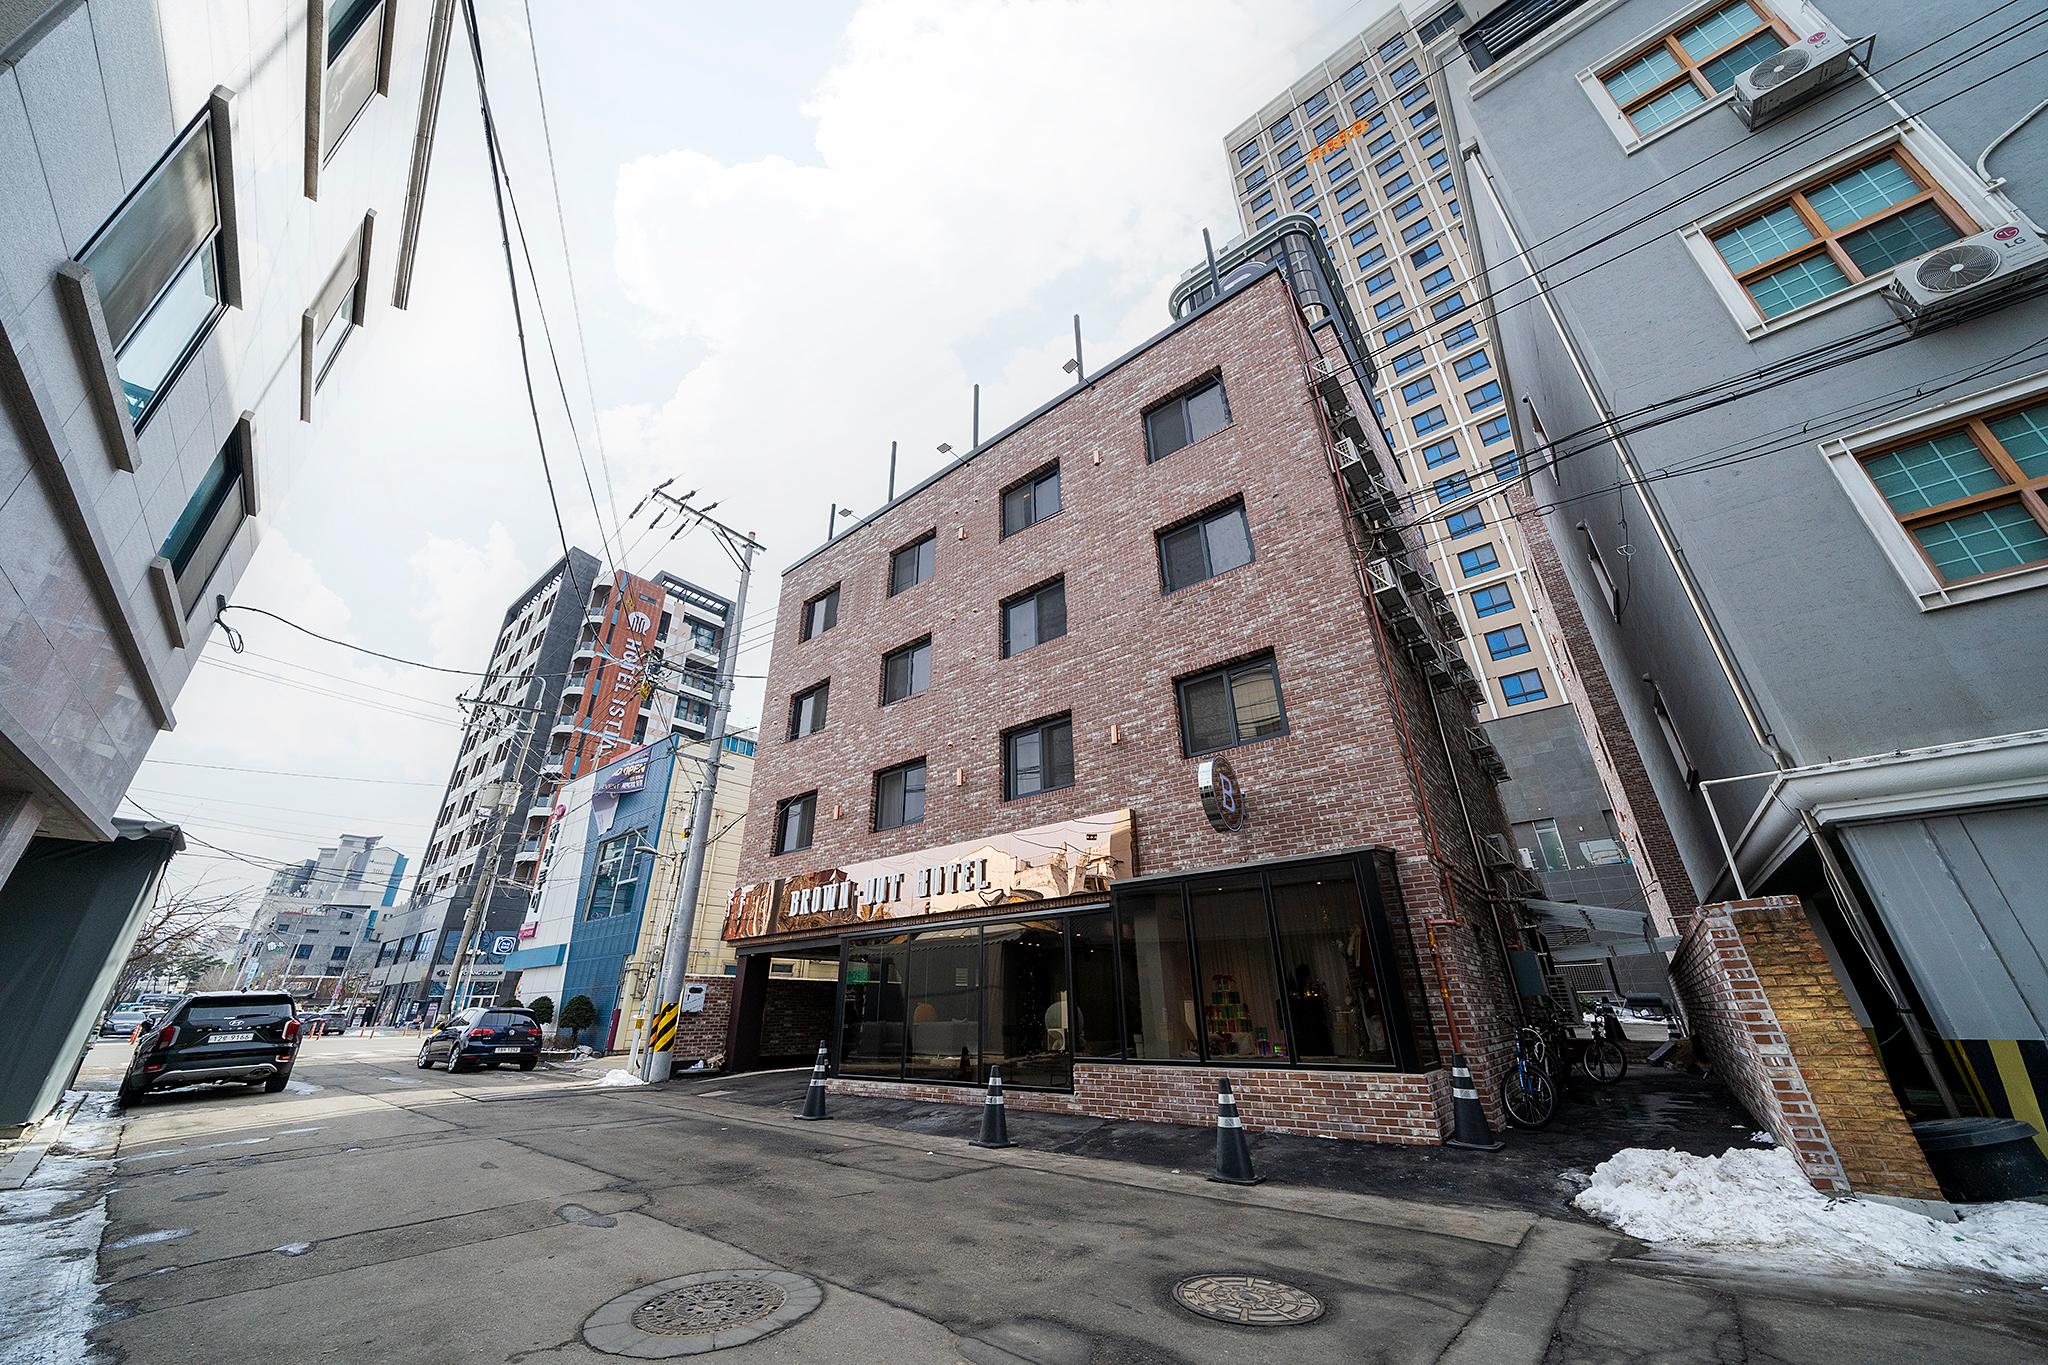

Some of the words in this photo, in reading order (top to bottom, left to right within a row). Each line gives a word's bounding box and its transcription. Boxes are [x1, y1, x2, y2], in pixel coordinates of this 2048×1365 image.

[1815, 39, 1830, 49] LG
[2004, 236, 2027, 249] LG
[614, 638, 642, 692] HOTEL
[623, 762, 647, 776] OPEN
[1220, 773, 1236, 812] B
[914, 858, 991, 898] HOTEL
